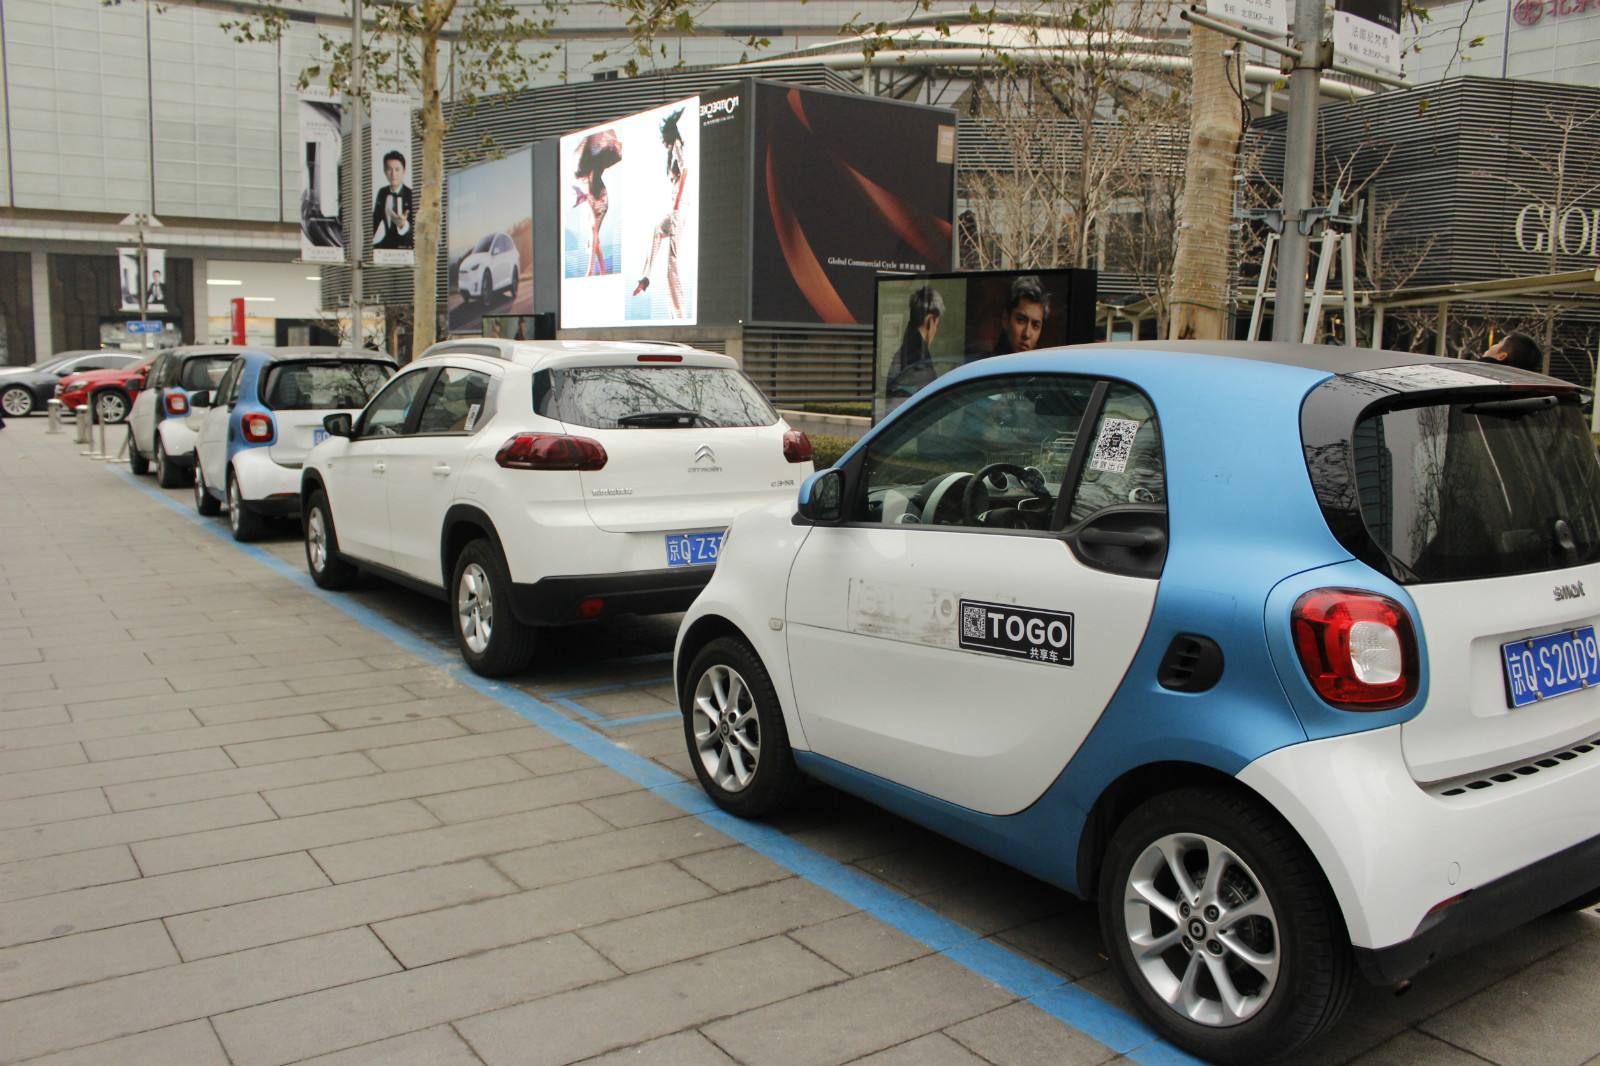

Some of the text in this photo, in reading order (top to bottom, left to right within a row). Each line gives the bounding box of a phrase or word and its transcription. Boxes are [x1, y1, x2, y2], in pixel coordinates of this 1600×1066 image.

[827, 256, 847, 266] Global
[847, 258, 881, 268] Commercial
[987, 612, 1068, 648] TOGO
[1029, 647, 1059, 662] 共享车
